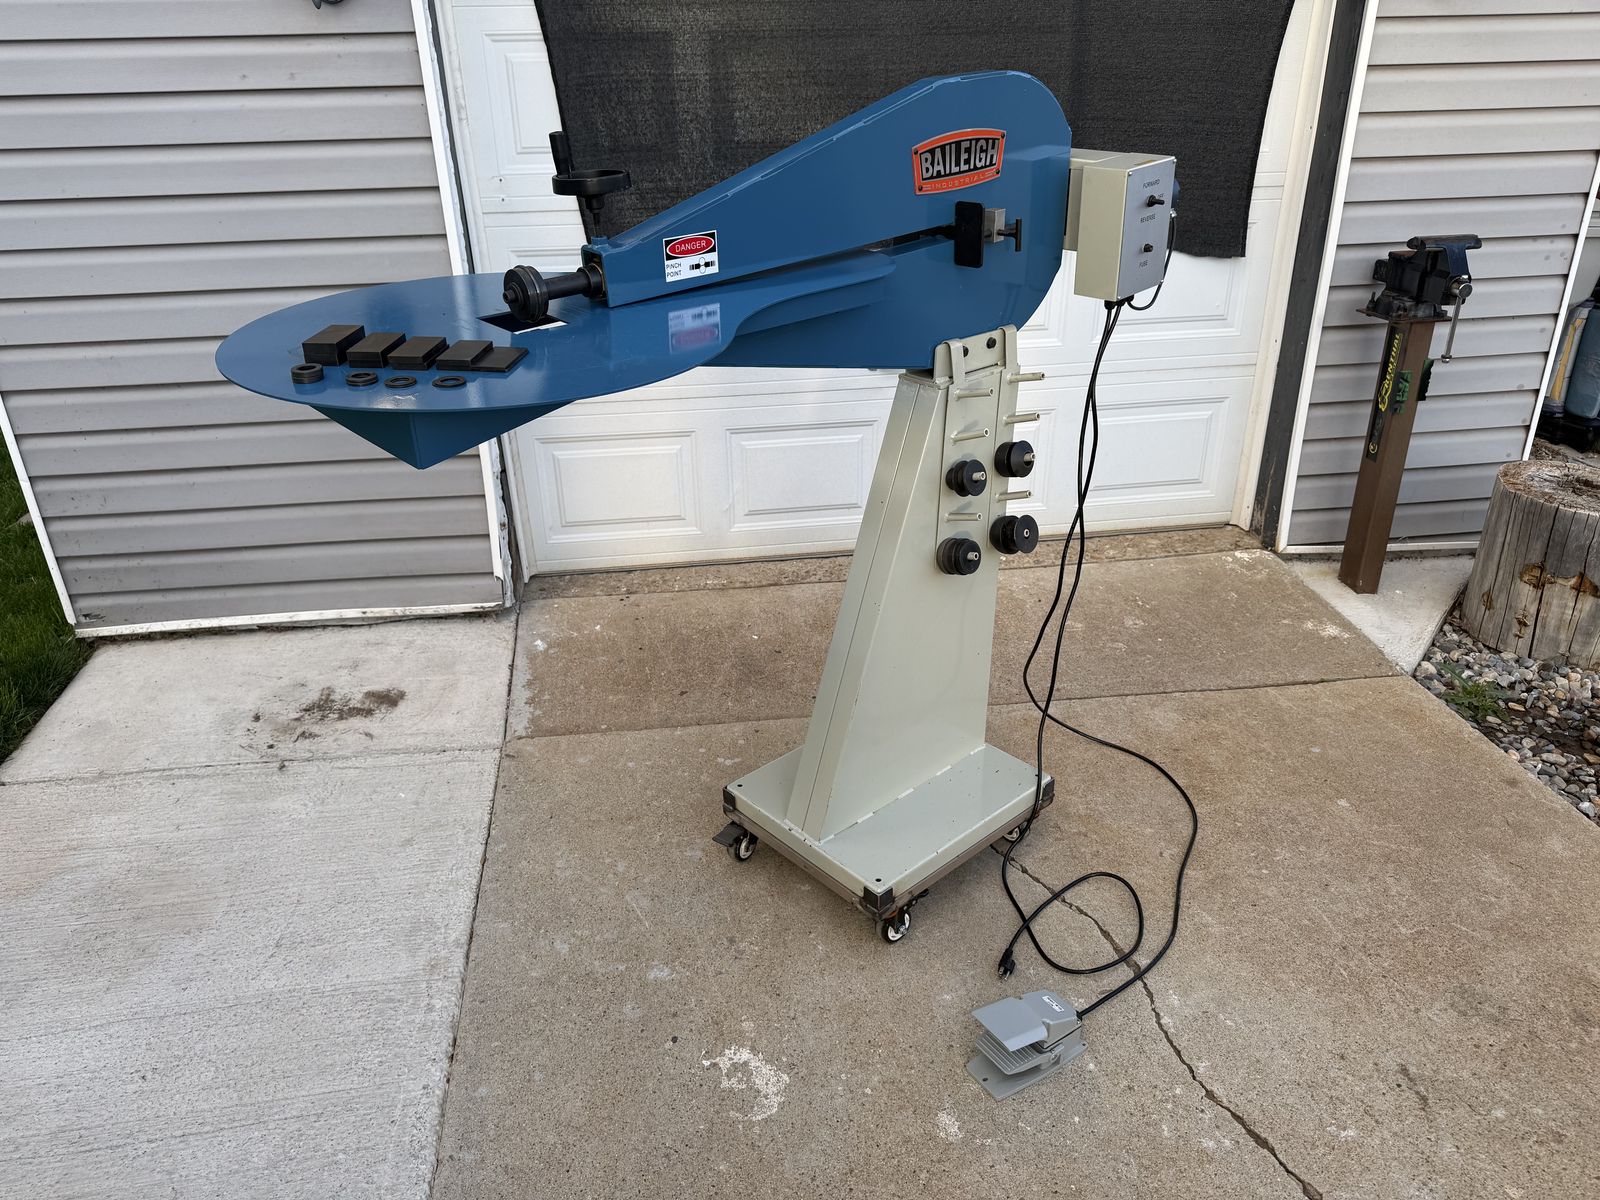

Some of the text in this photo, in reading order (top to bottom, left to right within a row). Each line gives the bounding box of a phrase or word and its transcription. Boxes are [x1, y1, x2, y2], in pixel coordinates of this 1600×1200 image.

[920, 139, 999, 179] BAILEIGH
[932, 174, 984, 189] INDUSTRIAL
[1142, 178, 1160, 188] FORWARD
[1140, 214, 1156, 223] REVERSE
[675, 240, 706, 252] DANGER
[666, 262, 682, 270] PINCH
